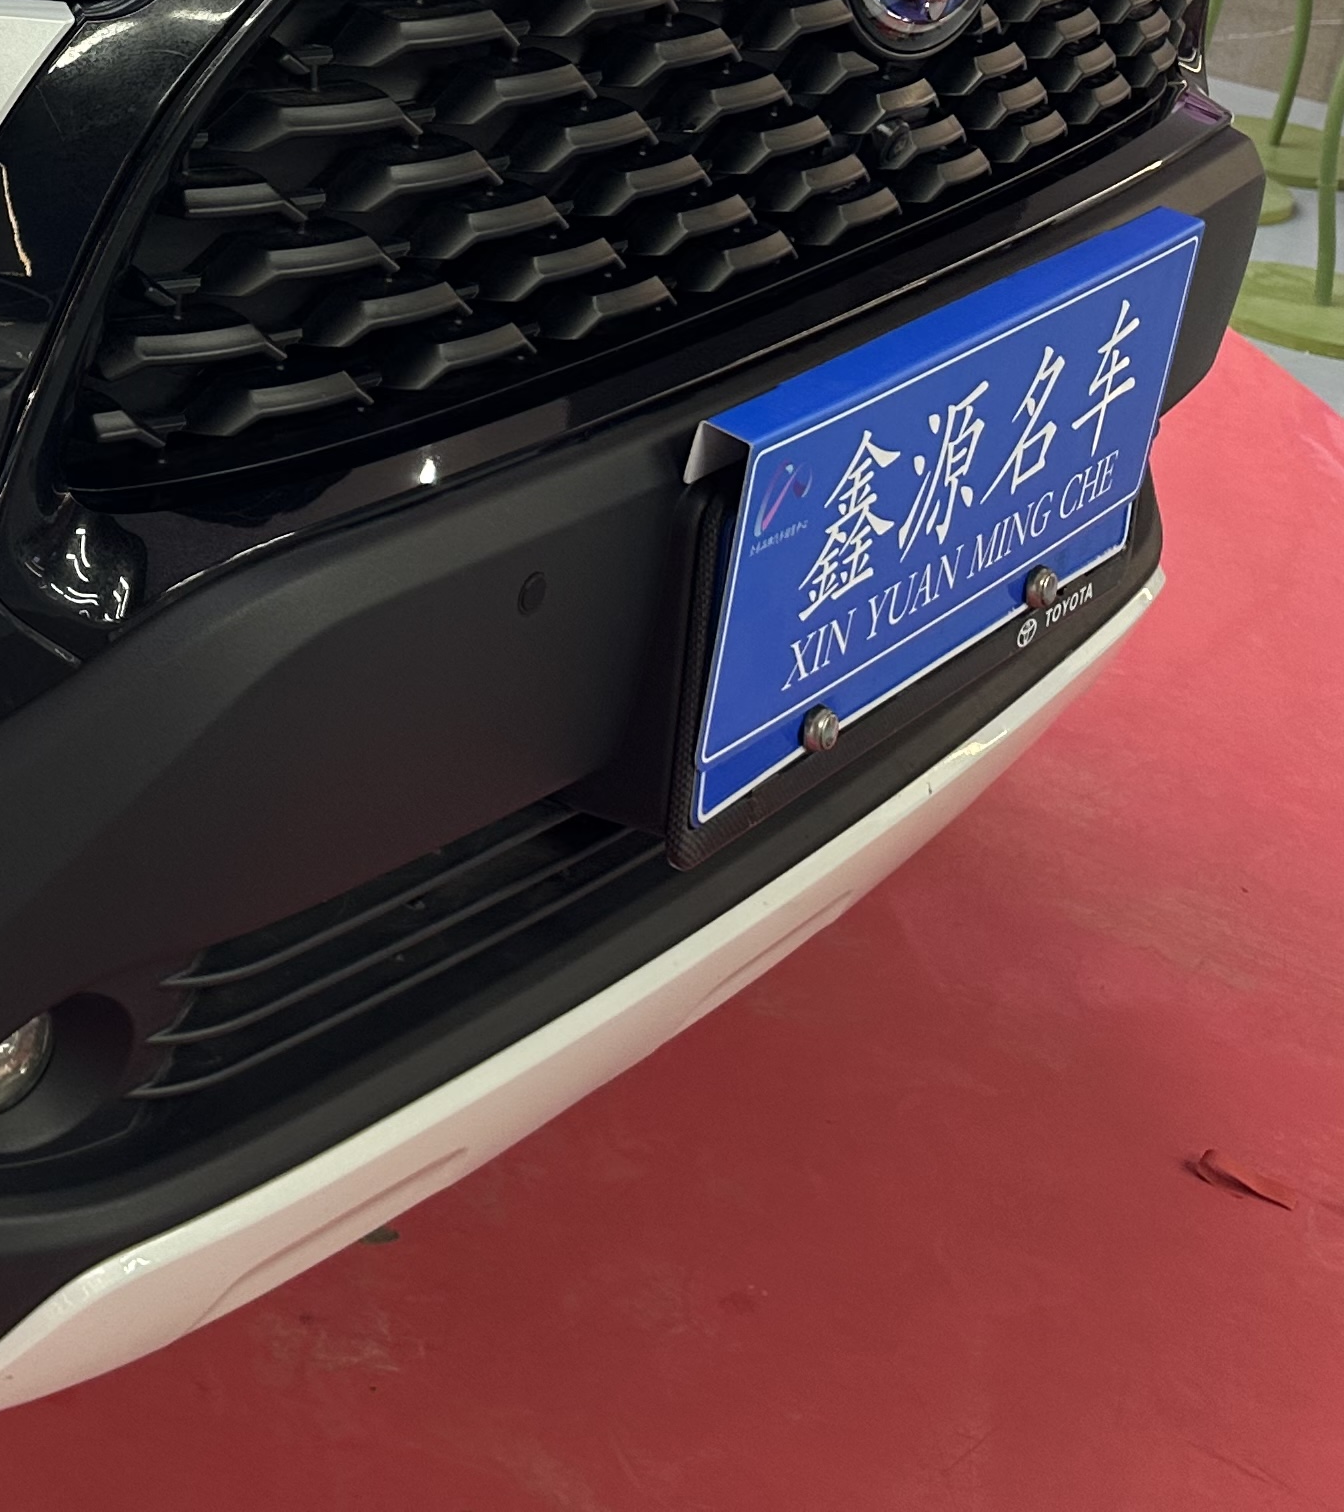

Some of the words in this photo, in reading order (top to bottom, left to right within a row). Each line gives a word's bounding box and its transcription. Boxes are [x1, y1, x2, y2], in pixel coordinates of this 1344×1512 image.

[781, 607, 858, 691] XIN
[866, 546, 964, 641] YUAN
[965, 491, 1055, 580] MING
[1059, 449, 1120, 522] CHE
[797, 300, 1140, 622] 鑫源名车
[1045, 582, 1093, 628] TOYOTA
